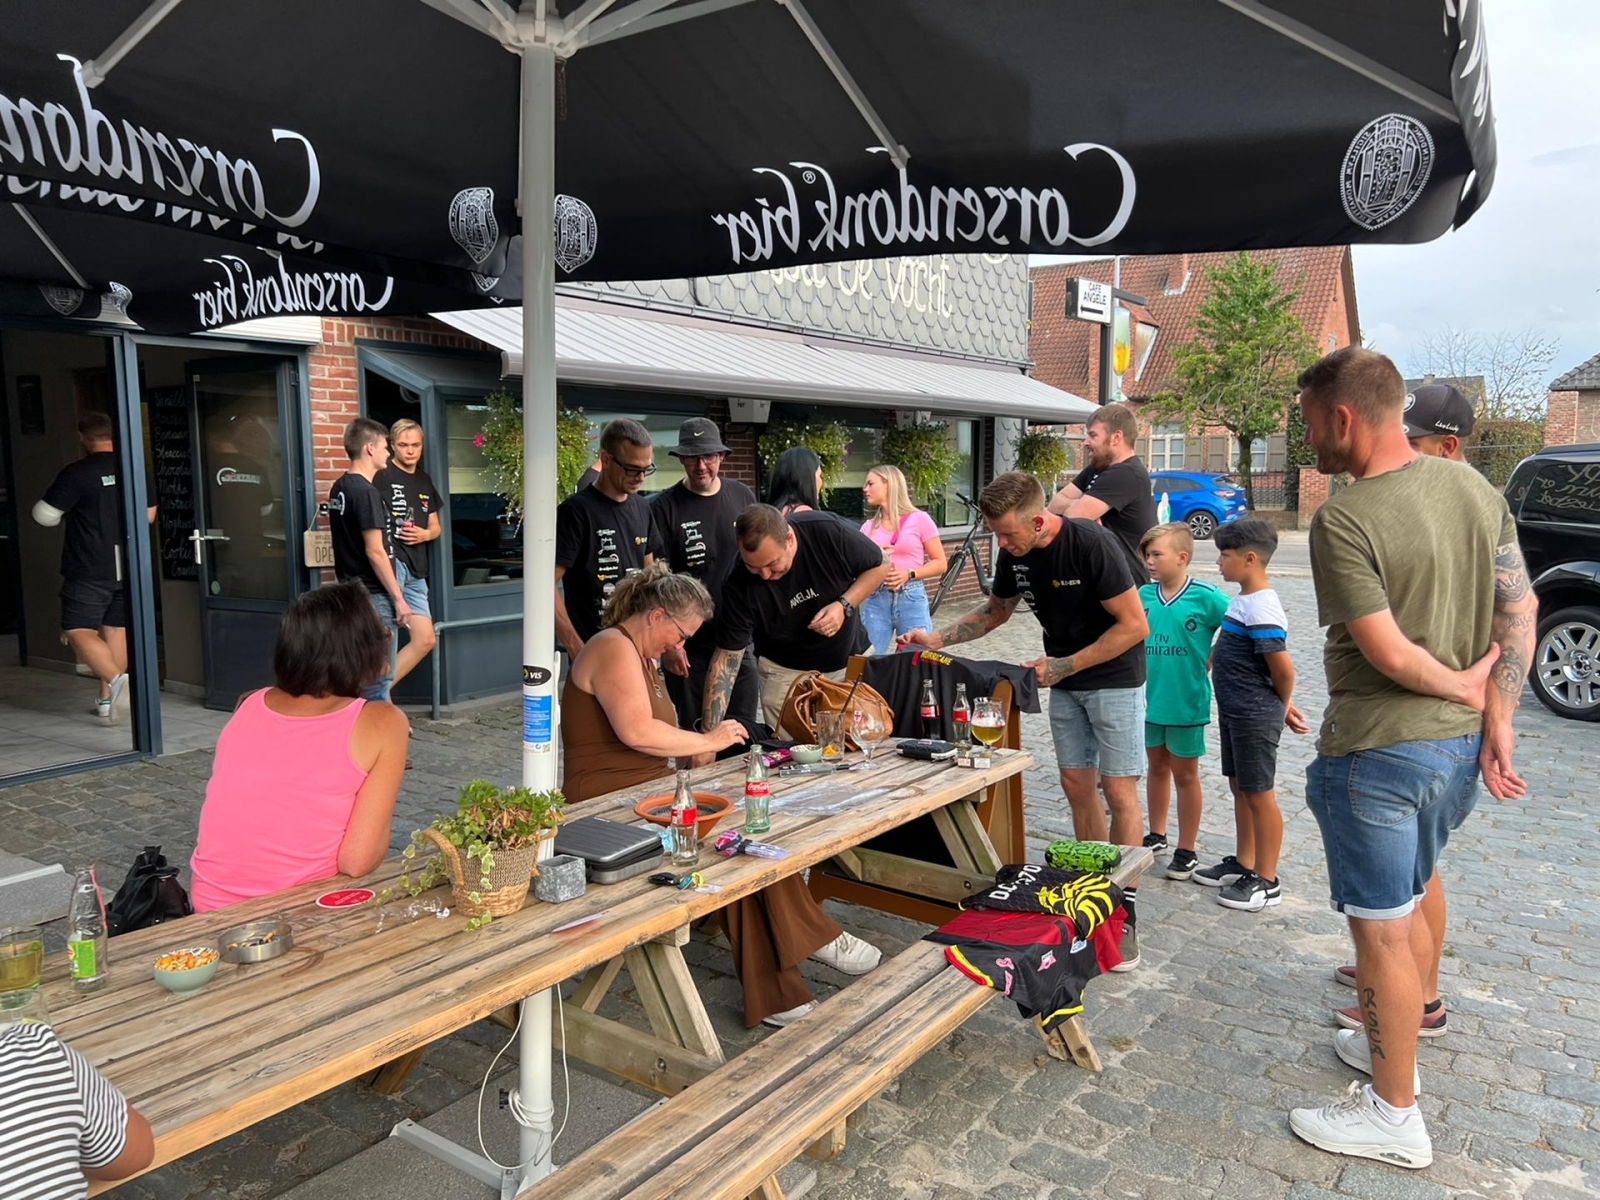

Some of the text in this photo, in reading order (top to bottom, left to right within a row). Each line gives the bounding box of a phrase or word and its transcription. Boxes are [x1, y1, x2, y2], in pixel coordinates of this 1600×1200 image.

[314, 546, 334, 564] OPE
[1154, 633, 1170, 644] Fly
[1145, 643, 1189, 656] mirates
